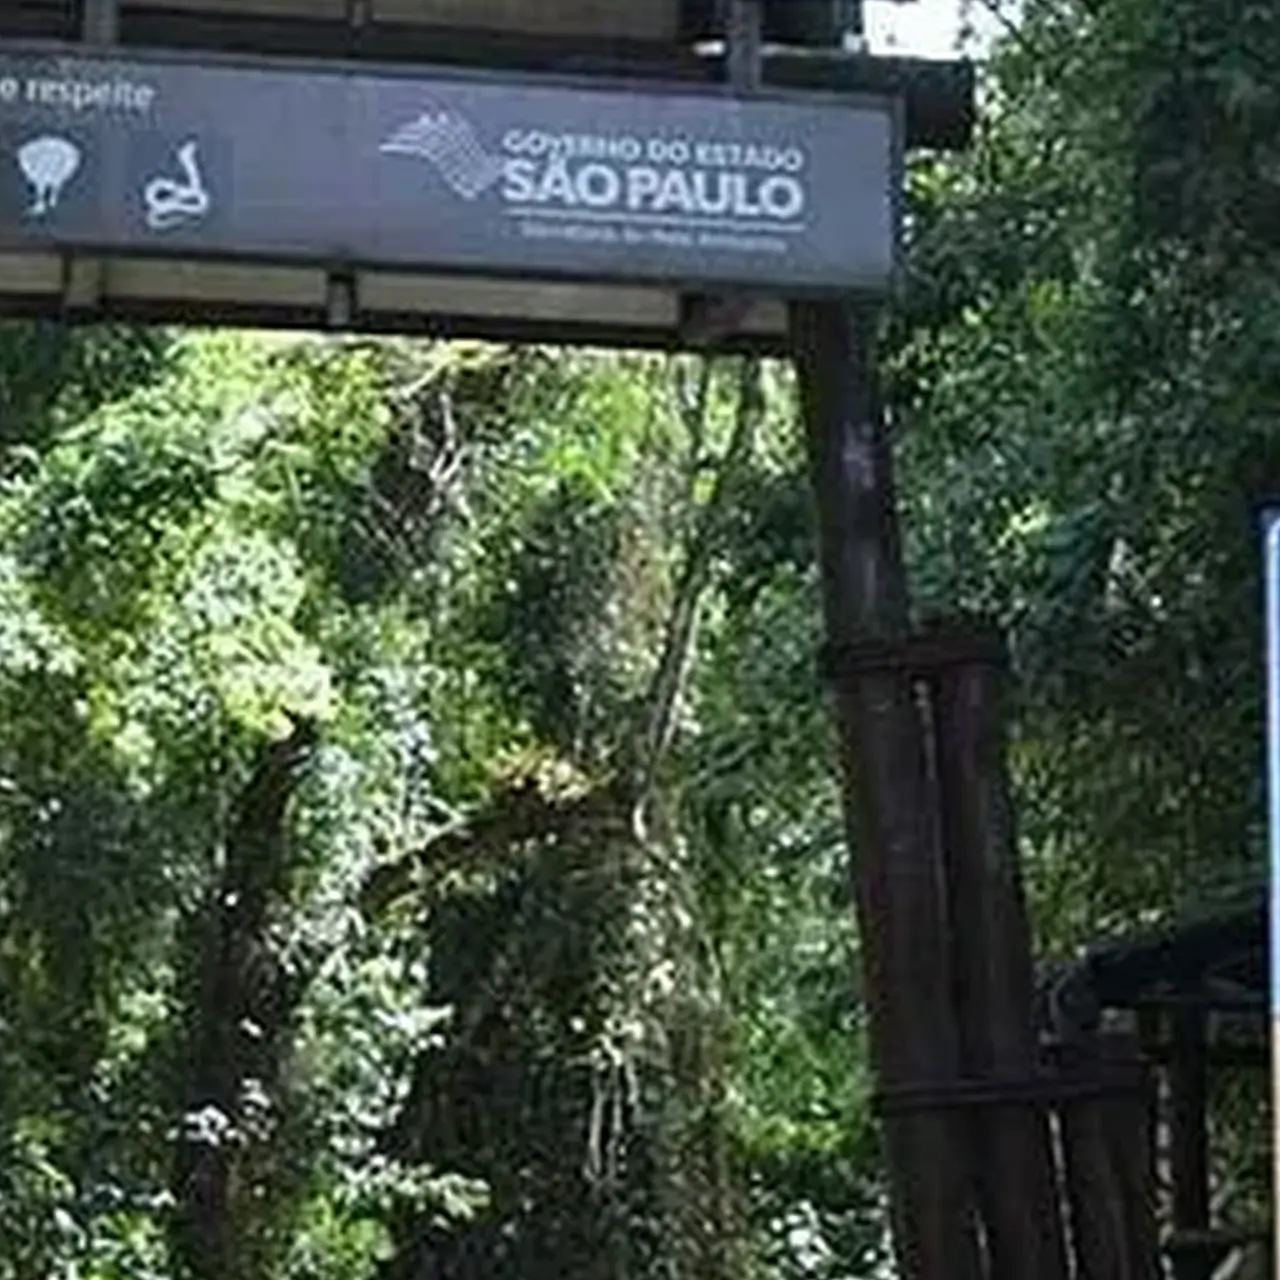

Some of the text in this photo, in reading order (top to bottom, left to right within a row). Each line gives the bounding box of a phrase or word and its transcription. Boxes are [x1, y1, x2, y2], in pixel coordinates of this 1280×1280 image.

[647, 139, 690, 163] DO
[695, 143, 804, 172] ESTADO
[502, 151, 804, 218] SÃO PAULO
